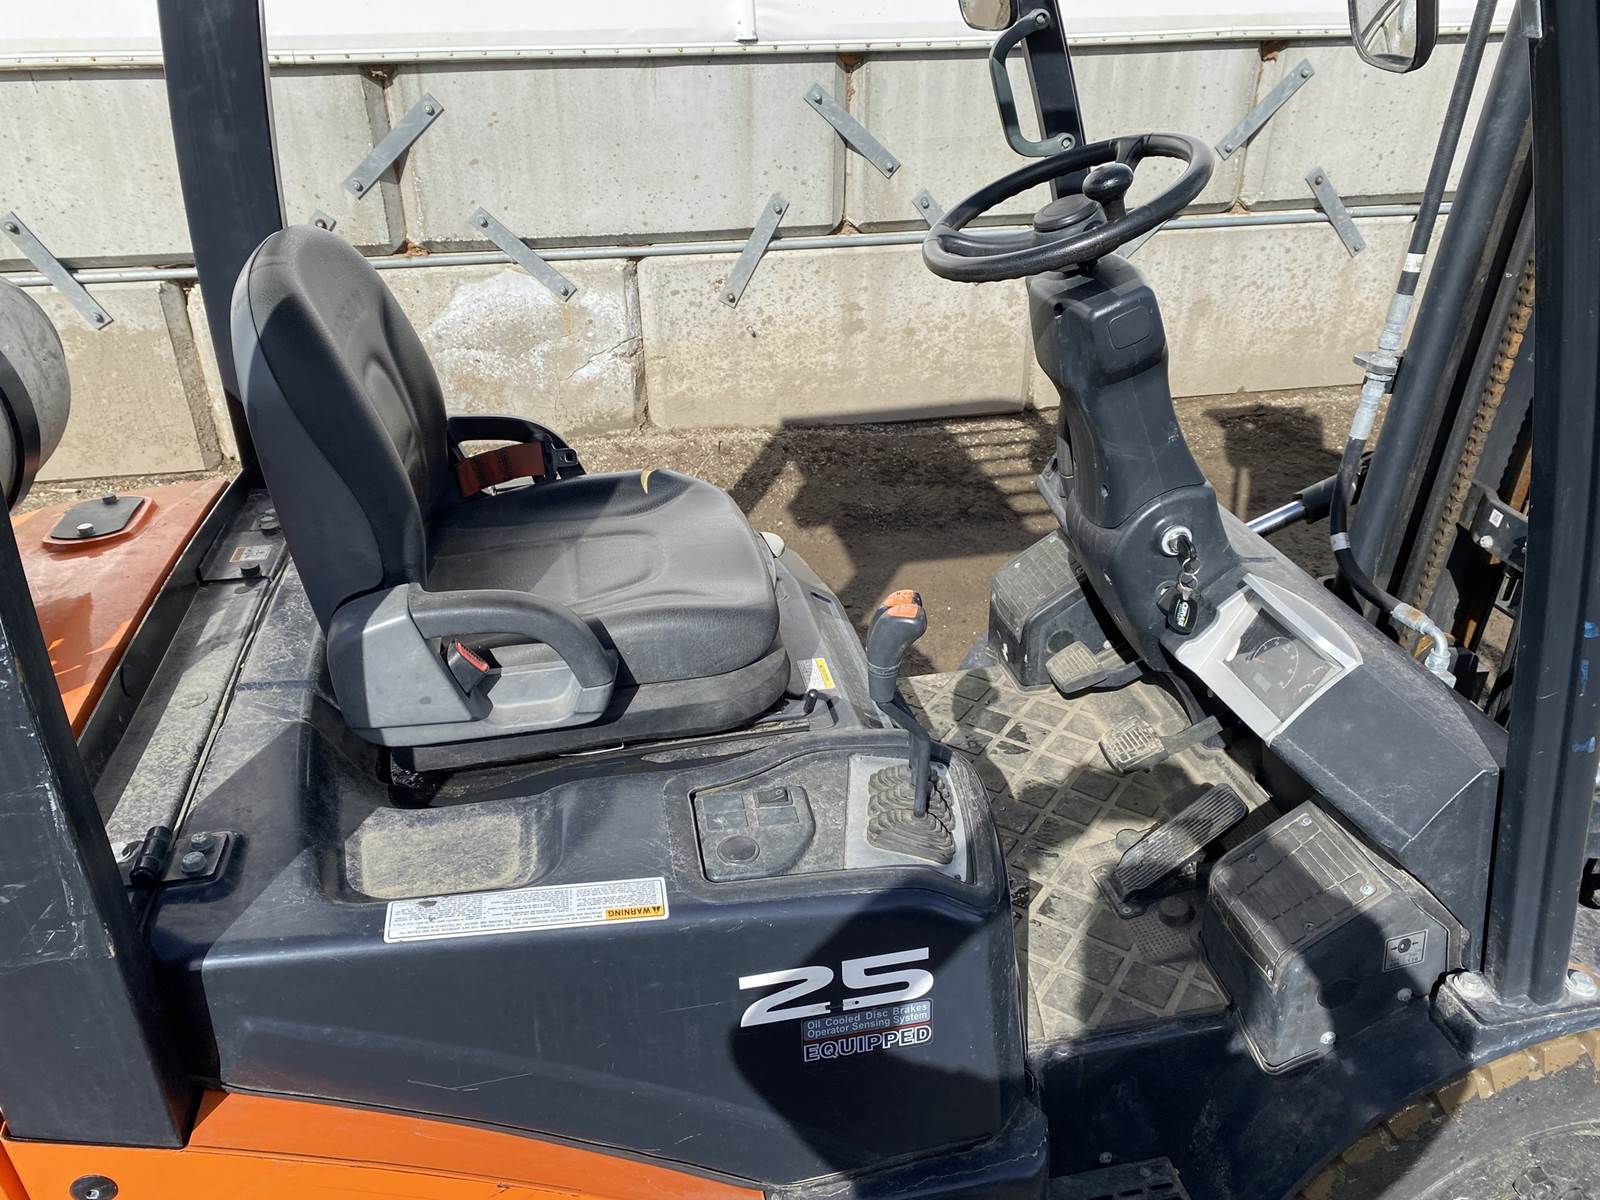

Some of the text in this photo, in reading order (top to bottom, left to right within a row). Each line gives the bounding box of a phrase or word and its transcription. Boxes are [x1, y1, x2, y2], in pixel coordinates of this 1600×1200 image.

[607, 907, 650, 917] WARNING
[807, 1004, 928, 1029] Oil Cooled Disc Brakes
[807, 1012, 927, 1038] Operator Sensing System
[804, 1025, 931, 1062] EQUIPPED
